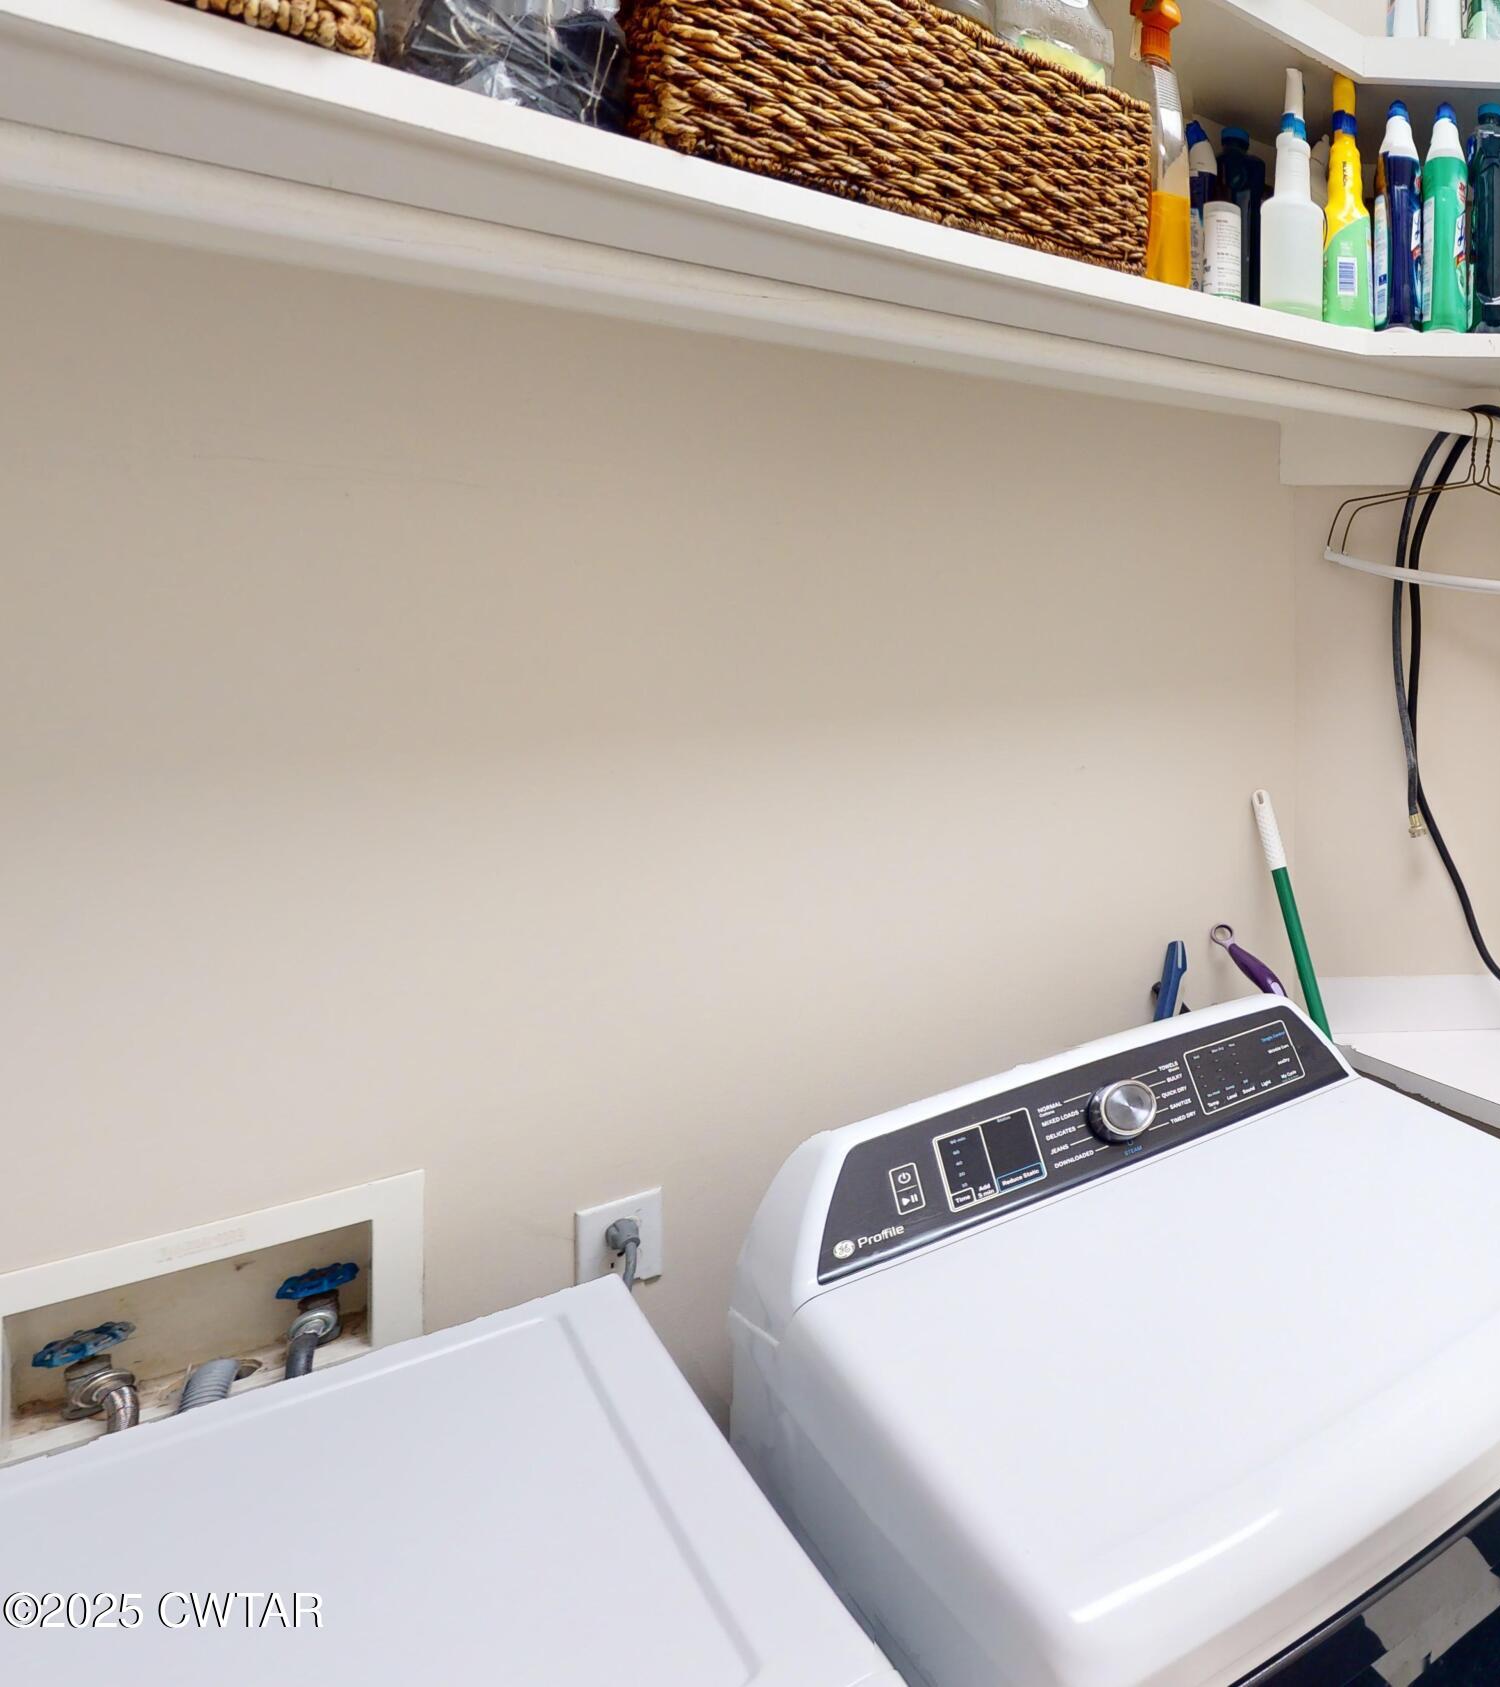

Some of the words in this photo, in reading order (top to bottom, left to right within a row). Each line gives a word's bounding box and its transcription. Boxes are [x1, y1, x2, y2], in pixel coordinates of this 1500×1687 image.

[1158, 1060, 1179, 1072] TOWELS
[1166, 1073, 1183, 1083] BULKY
[1261, 1079, 1272, 1088] Light
[1161, 1088, 1178, 1099] QUICK
[1177, 1085, 1187, 1094] DRY
[1242, 1086, 1256, 1094] Sound
[1226, 1092, 1238, 1101] Level
[1037, 1101, 1063, 1113] NORMAL
[1169, 1098, 1192, 1110] SANITIZE
[1207, 1100, 1220, 1108] Temp
[1041, 1116, 1061, 1127] MIXED
[1060, 1110, 1080, 1121] LOADS
[1170, 1113, 1186, 1124] TIMED
[1186, 1110, 1197, 1119] DRY
[1045, 1126, 1077, 1141] DELICATES
[1050, 1144, 1069, 1155] JEANS
[1124, 1145, 1143, 1157] STEAM
[1054, 1149, 1095, 1168] DOWNLOADED
[1001, 1174, 1023, 1186] Reduce
[1022, 1168, 1040, 1179] Static
[979, 1183, 991, 1192] Add
[983, 1189, 995, 1197] min
[955, 1195, 971, 1204] Time
